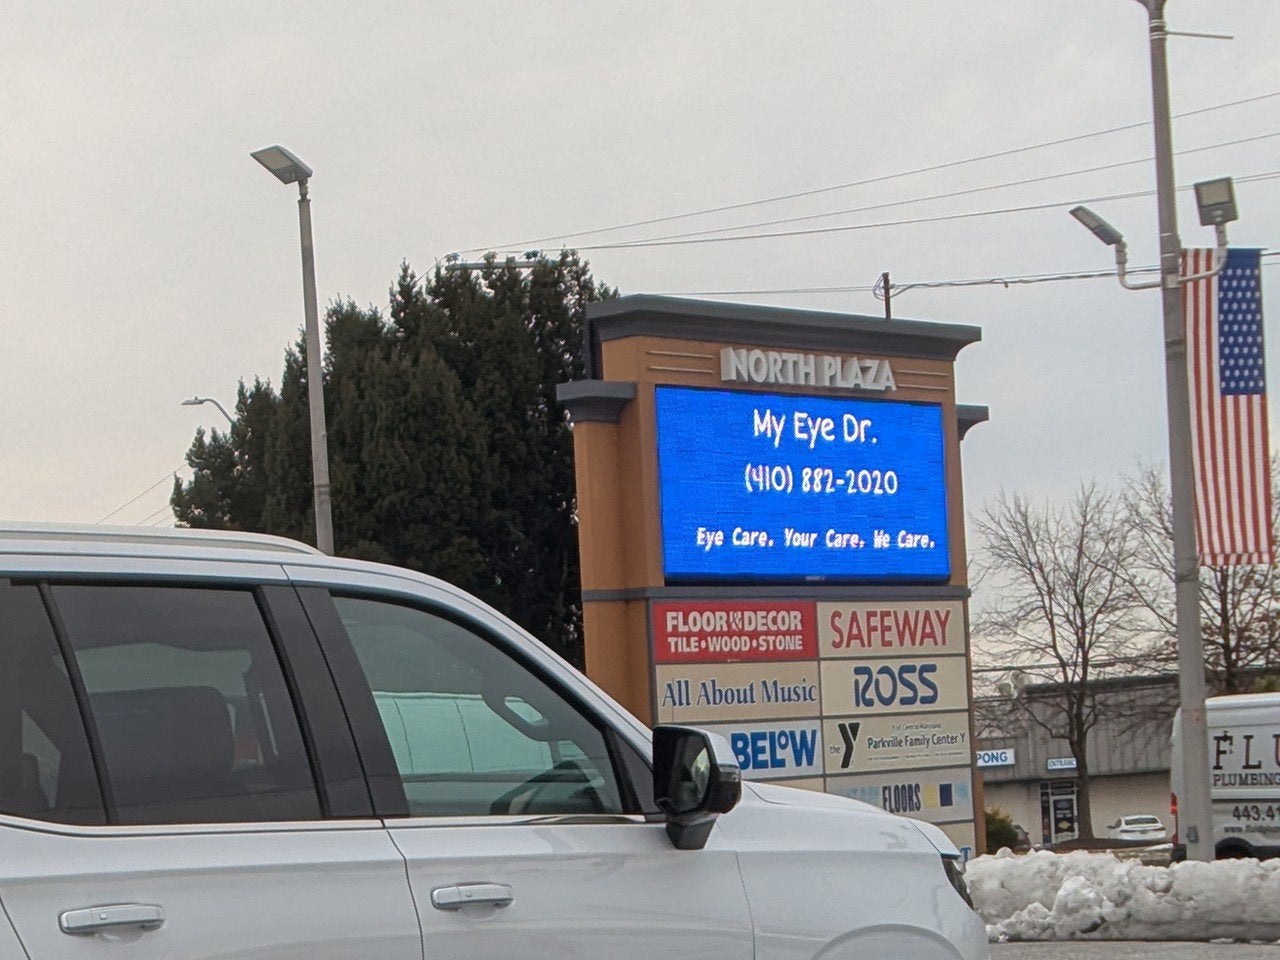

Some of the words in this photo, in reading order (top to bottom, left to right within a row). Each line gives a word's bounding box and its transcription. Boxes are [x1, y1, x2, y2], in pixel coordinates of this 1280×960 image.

[720, 347, 815, 386] NORTH
[817, 355, 897, 391] PLAZA
[753, 408, 786, 449] My
[794, 411, 835, 450] Eye
[842, 413, 878, 444] Dr.
[744, 463, 794, 494] (410)
[801, 466, 899, 496] 882-2020
[696, 526, 724, 551] Eye
[732, 526, 775, 548] Care.
[783, 527, 819, 548] Your
[825, 529, 866, 550] Care.
[873, 529, 891, 549] We
[897, 530, 936, 550] Care.
[829, 609, 951, 650] SAFEWAY
[662, 679, 692, 708] All
[696, 679, 757, 706] About
[761, 677, 818, 703] Music
[853, 663, 939, 708] ROSS
[730, 729, 818, 770] BELOW
[867, 736, 903, 750] Parkville
[904, 732, 931, 749] Family
[931, 732, 959, 746] Center
[882, 782, 921, 814] FLOORS
